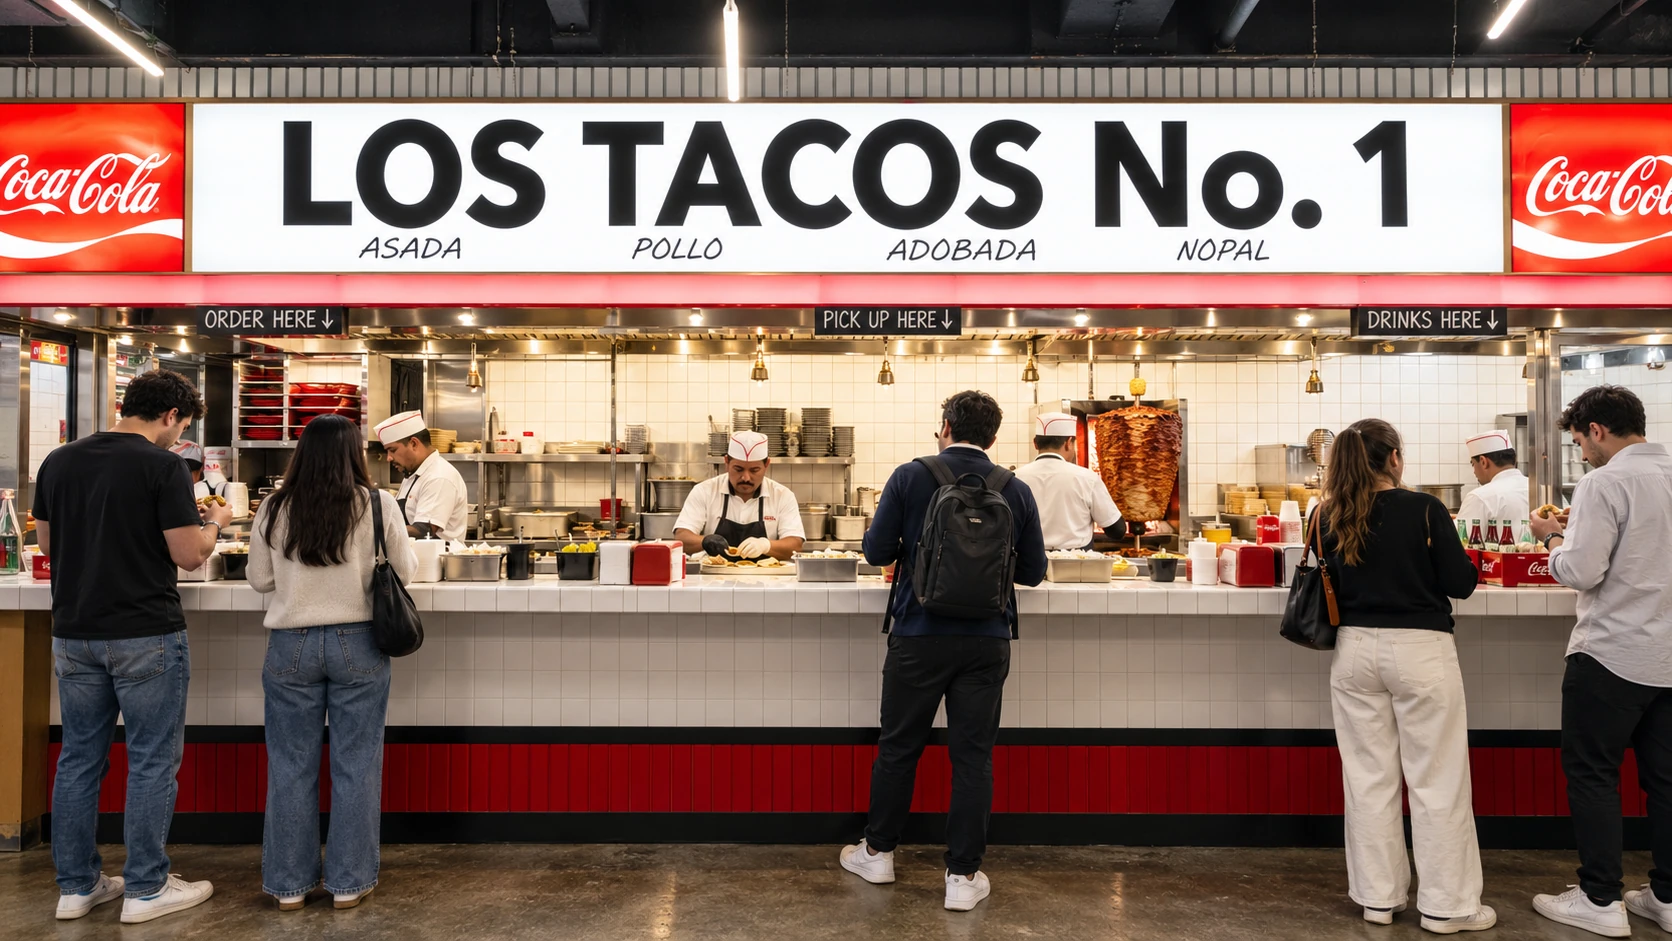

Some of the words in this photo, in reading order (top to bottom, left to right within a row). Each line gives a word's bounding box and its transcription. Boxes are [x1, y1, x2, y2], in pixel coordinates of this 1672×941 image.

[283, 119, 545, 229] LOS
[583, 119, 1043, 230] TACOS
[1095, 121, 1322, 230] No.
[1353, 121, 1407, 227] 1
[359, 237, 461, 260] ASADA
[632, 237, 723, 260] POLLO
[887, 238, 1036, 261] ADOBADA
[1177, 238, 1270, 261] NOPAL
[204, 309, 265, 329] ORDER
[273, 309, 316, 328] HERE
[823, 310, 861, 329] PICK
[868, 310, 890, 329] UP
[897, 310, 937, 329] HERE
[1367, 310, 1433, 329] DRINKS
[1441, 310, 1482, 329] HERE
